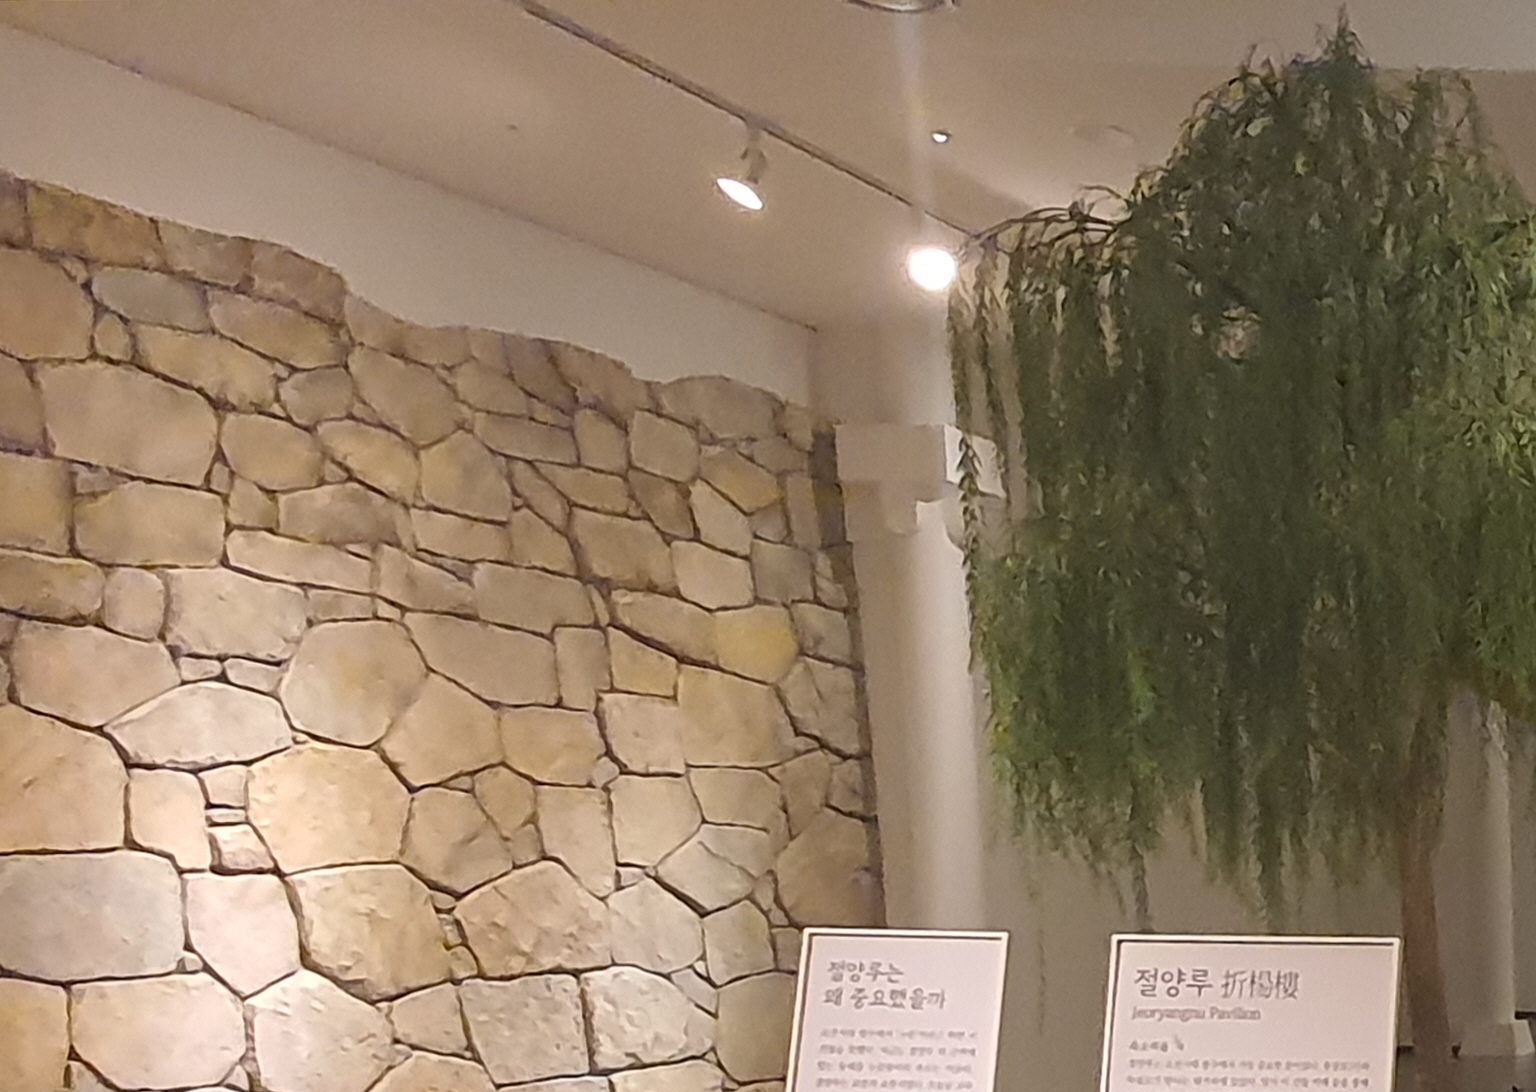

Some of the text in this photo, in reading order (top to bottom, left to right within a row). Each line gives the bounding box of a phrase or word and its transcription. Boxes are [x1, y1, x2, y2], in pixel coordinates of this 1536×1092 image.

[827, 960, 904, 983] 절양루는
[1134, 967, 1213, 998] 절양루
[823, 986, 945, 1010] 왜 중요했을까
